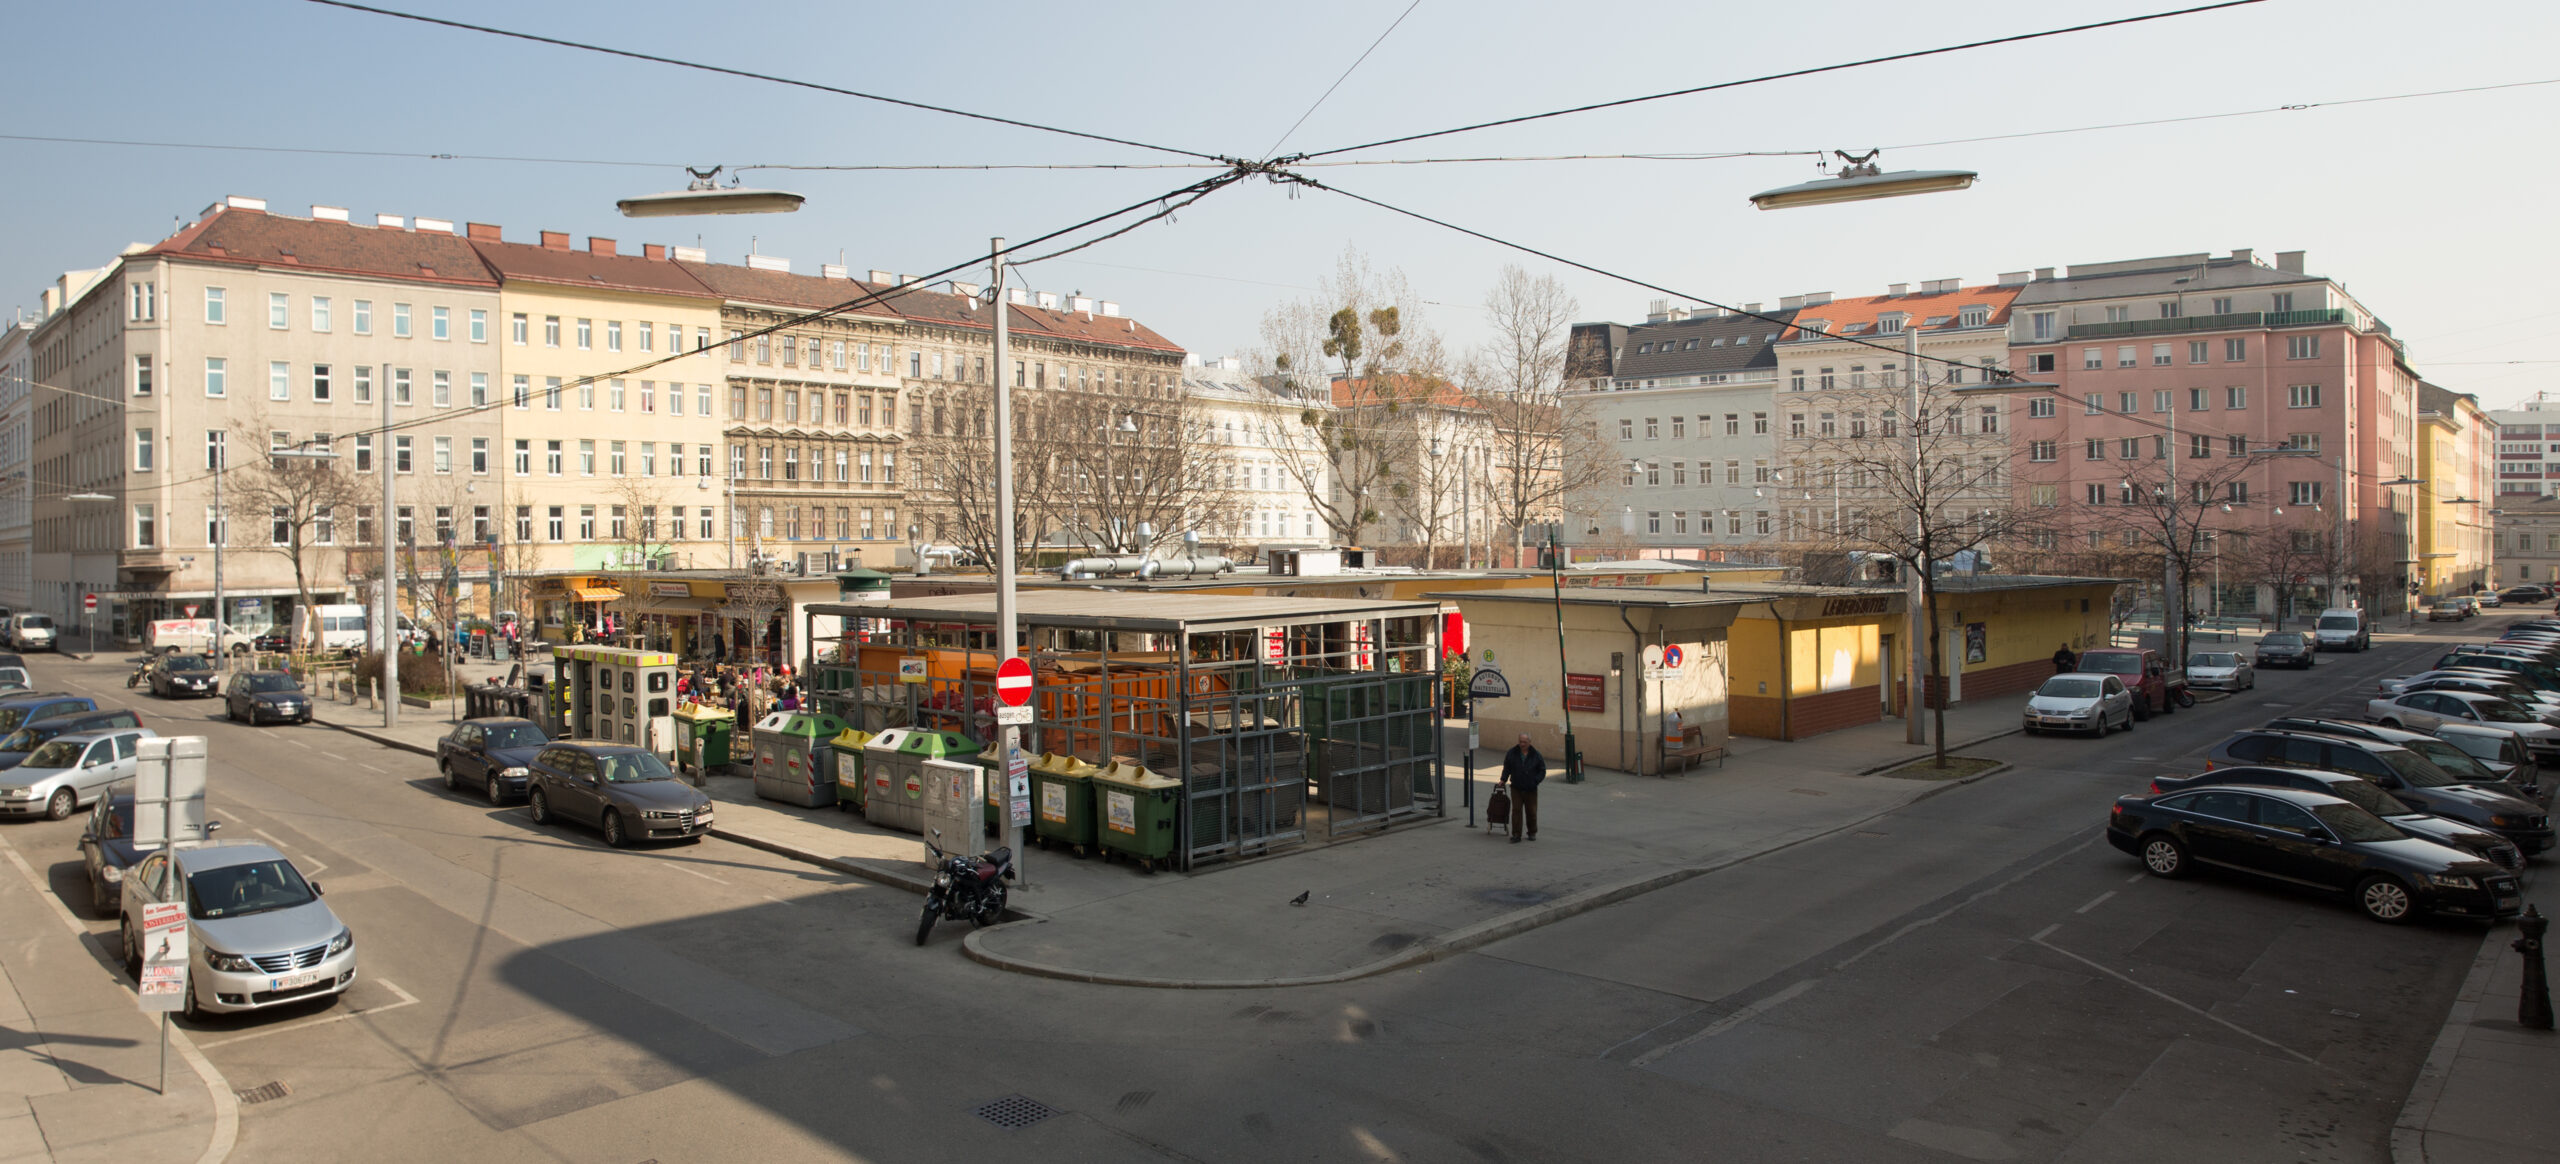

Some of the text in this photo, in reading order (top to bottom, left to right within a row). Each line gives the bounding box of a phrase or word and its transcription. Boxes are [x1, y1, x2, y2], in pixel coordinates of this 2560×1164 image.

[1478, 672, 1501, 683] AUTOBUS
[1474, 685, 1505, 693] HALTESTELLE
[156, 904, 178, 913] Sonntag
